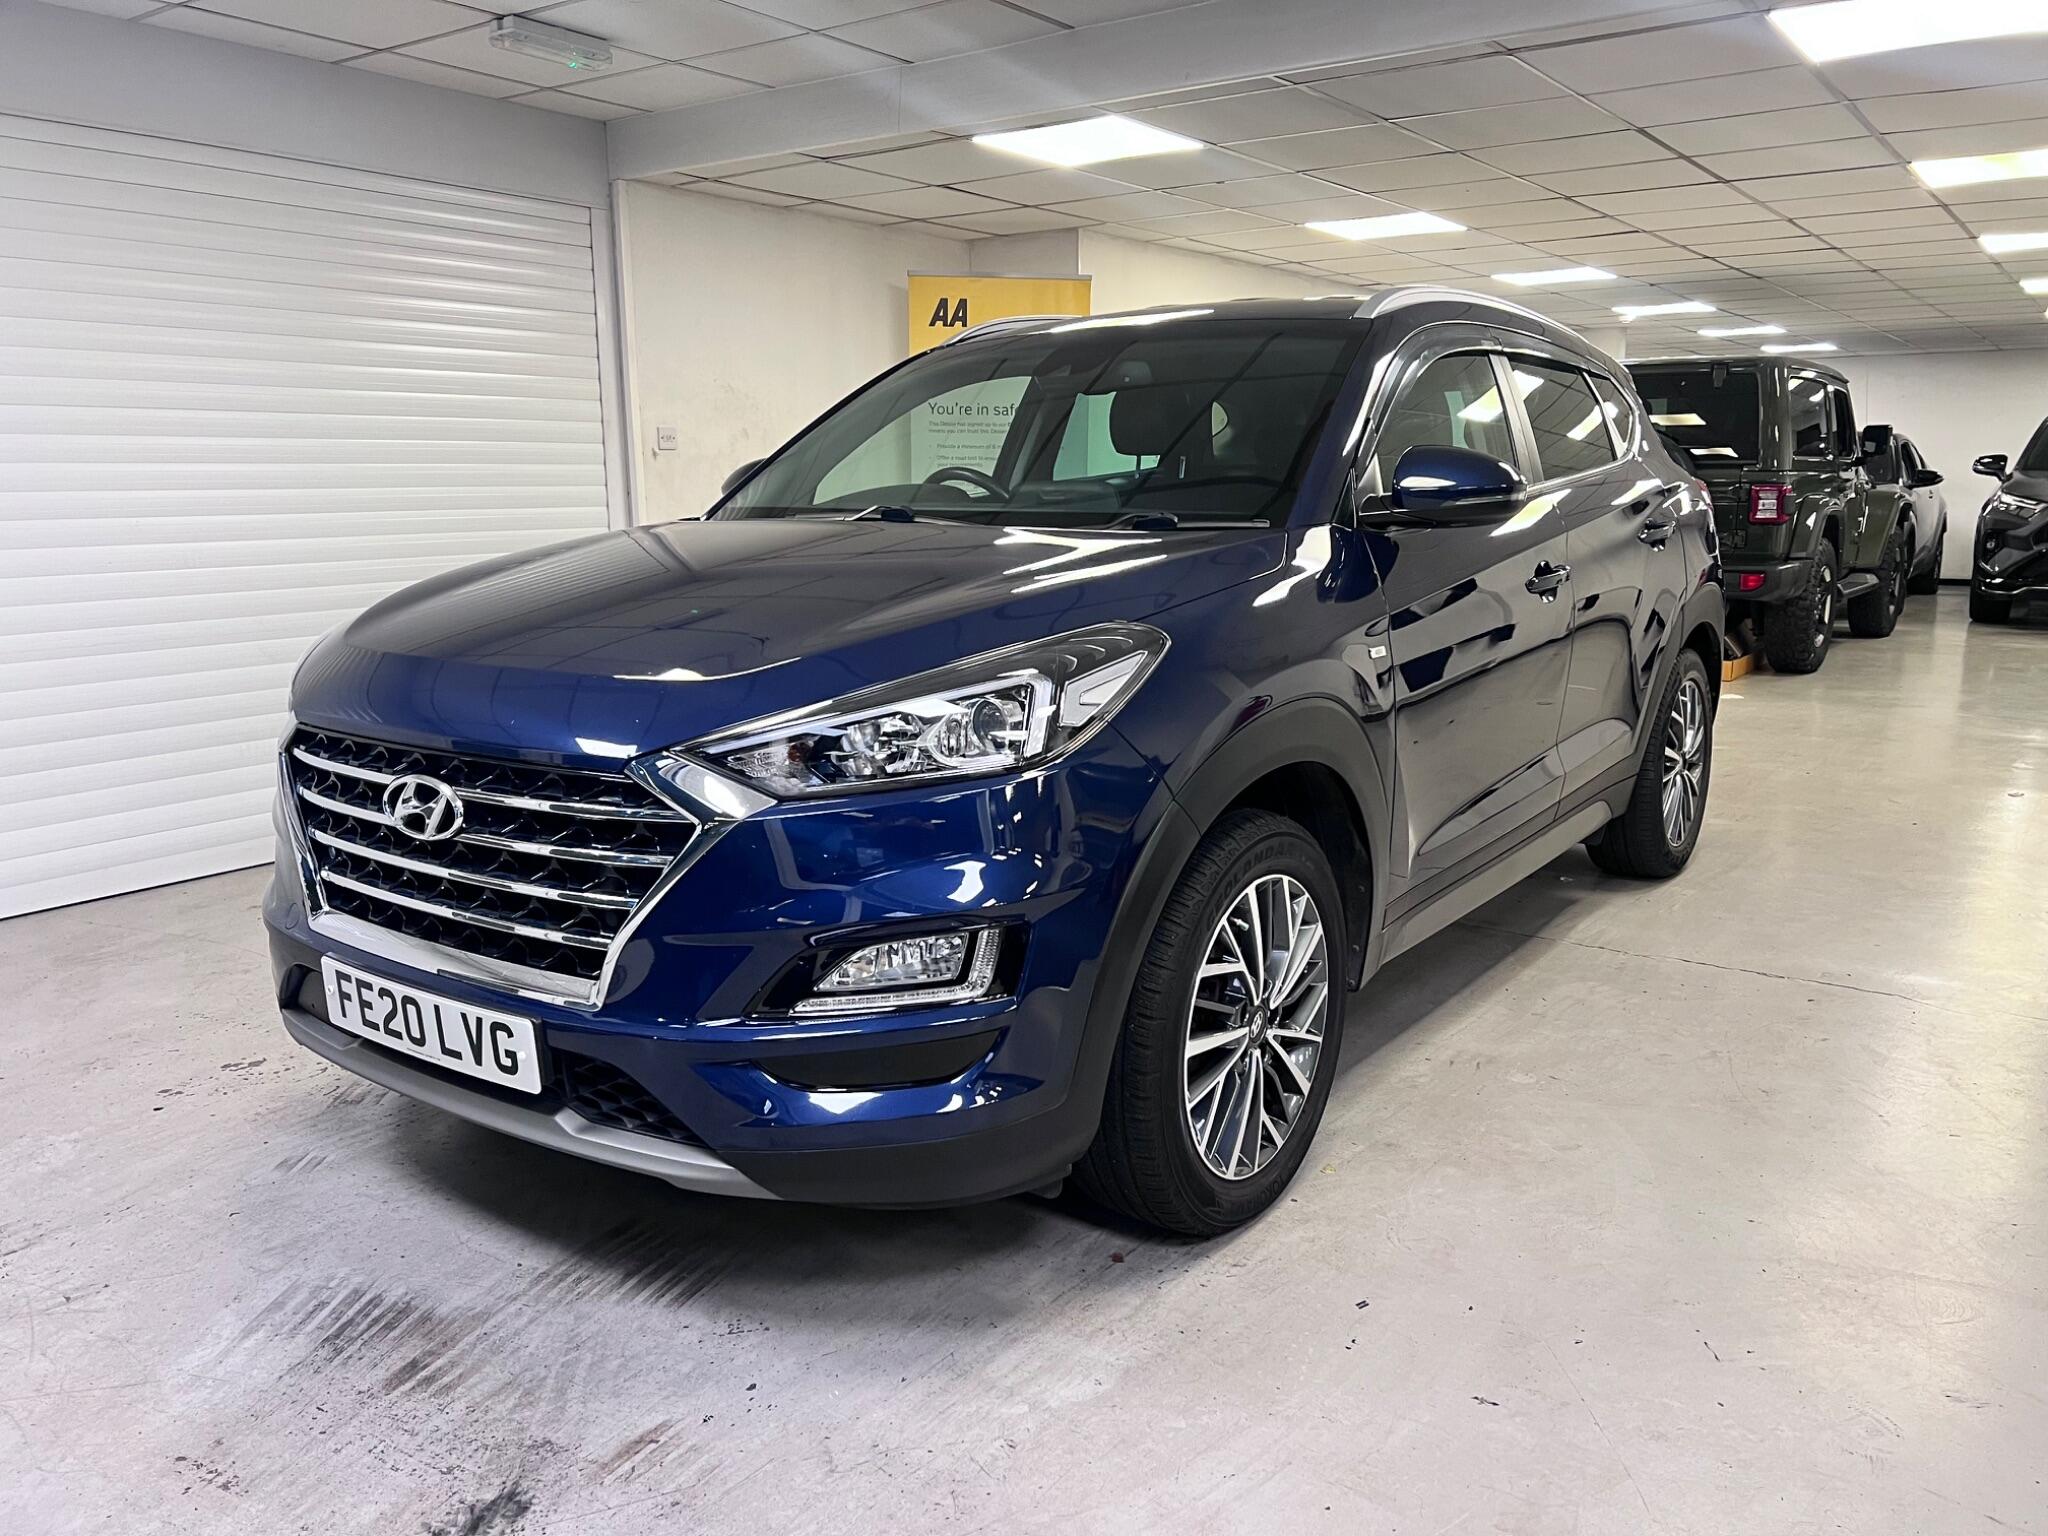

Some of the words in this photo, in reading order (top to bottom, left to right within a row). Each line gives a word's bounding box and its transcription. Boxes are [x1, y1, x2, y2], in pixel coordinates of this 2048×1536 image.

[928, 297, 968, 328] AA
[928, 401, 973, 416] You're
[977, 402, 989, 416] in
[993, 403, 1016, 417] saf
[334, 969, 427, 1048] FE20
[433, 1003, 519, 1076] LVG
